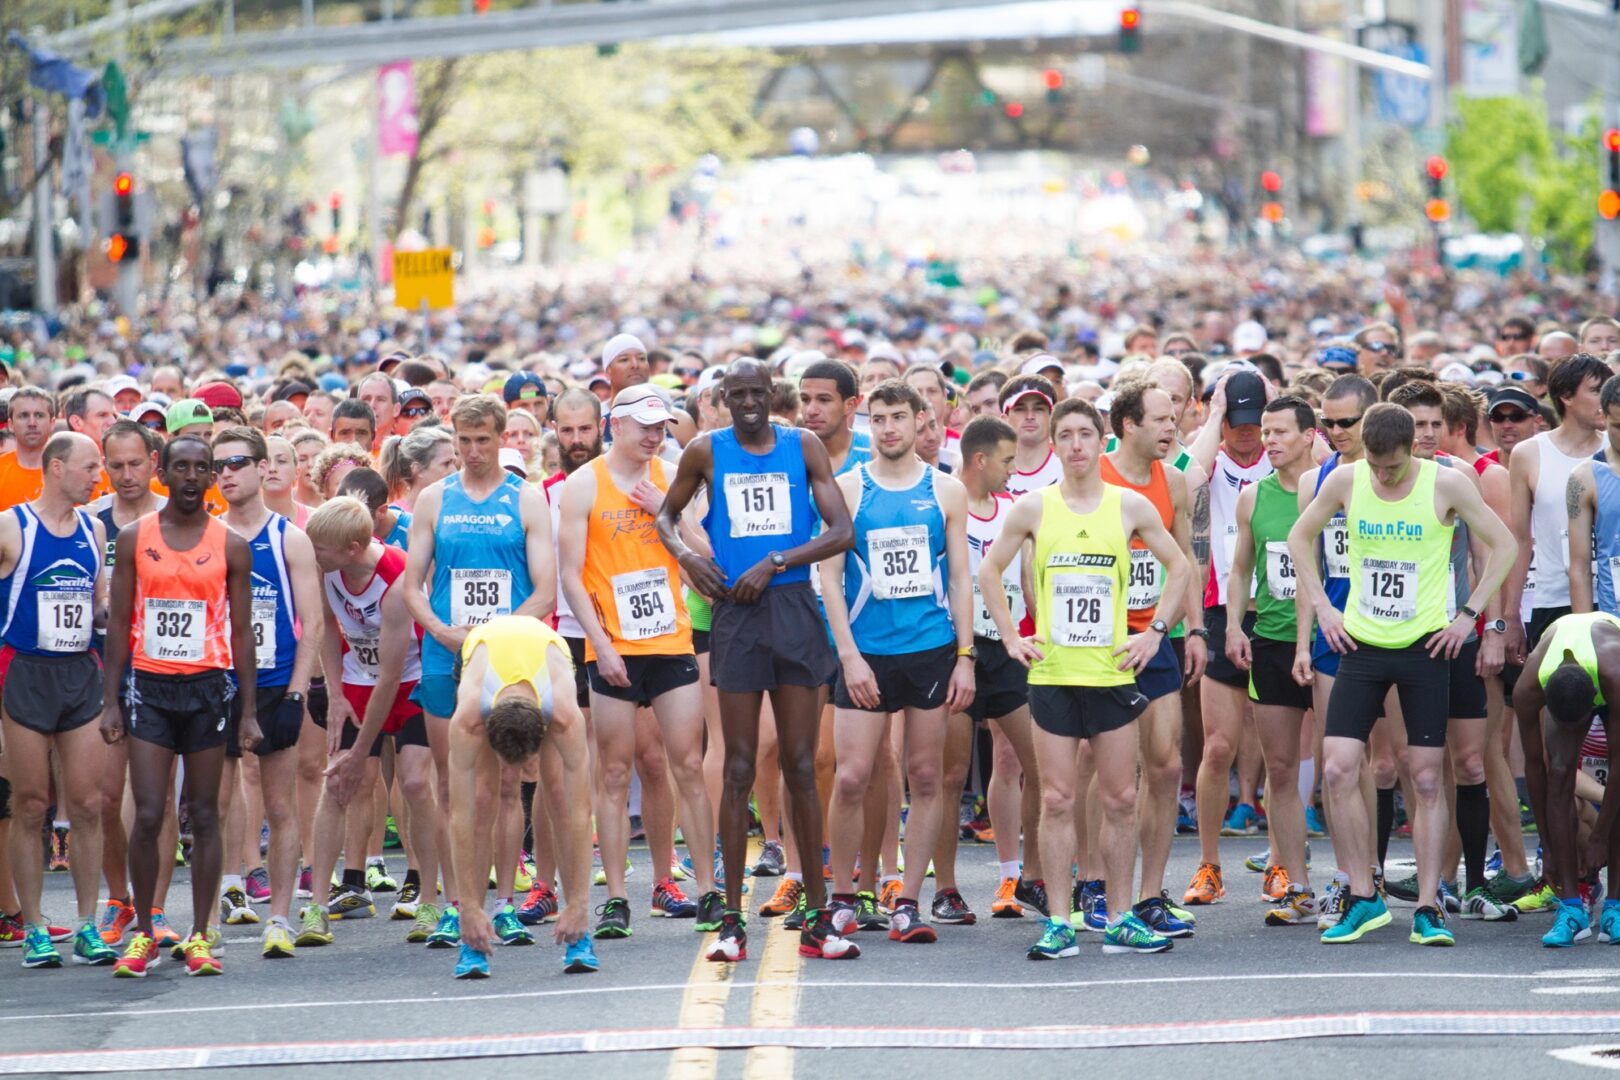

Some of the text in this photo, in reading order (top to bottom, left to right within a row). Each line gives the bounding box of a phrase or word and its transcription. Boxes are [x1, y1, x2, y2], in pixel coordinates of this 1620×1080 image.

[741, 487, 774, 512] 151
[443, 514, 495, 525] PARAGON
[1359, 519, 1422, 536] Run n Fun
[883, 550, 919, 576] 352
[464, 581, 499, 606] 353
[1371, 572, 1405, 599] 125
[54, 604, 83, 629] 152
[629, 592, 664, 619] 354
[1066, 598, 1101, 624] 126
[156, 611, 193, 638] 332
